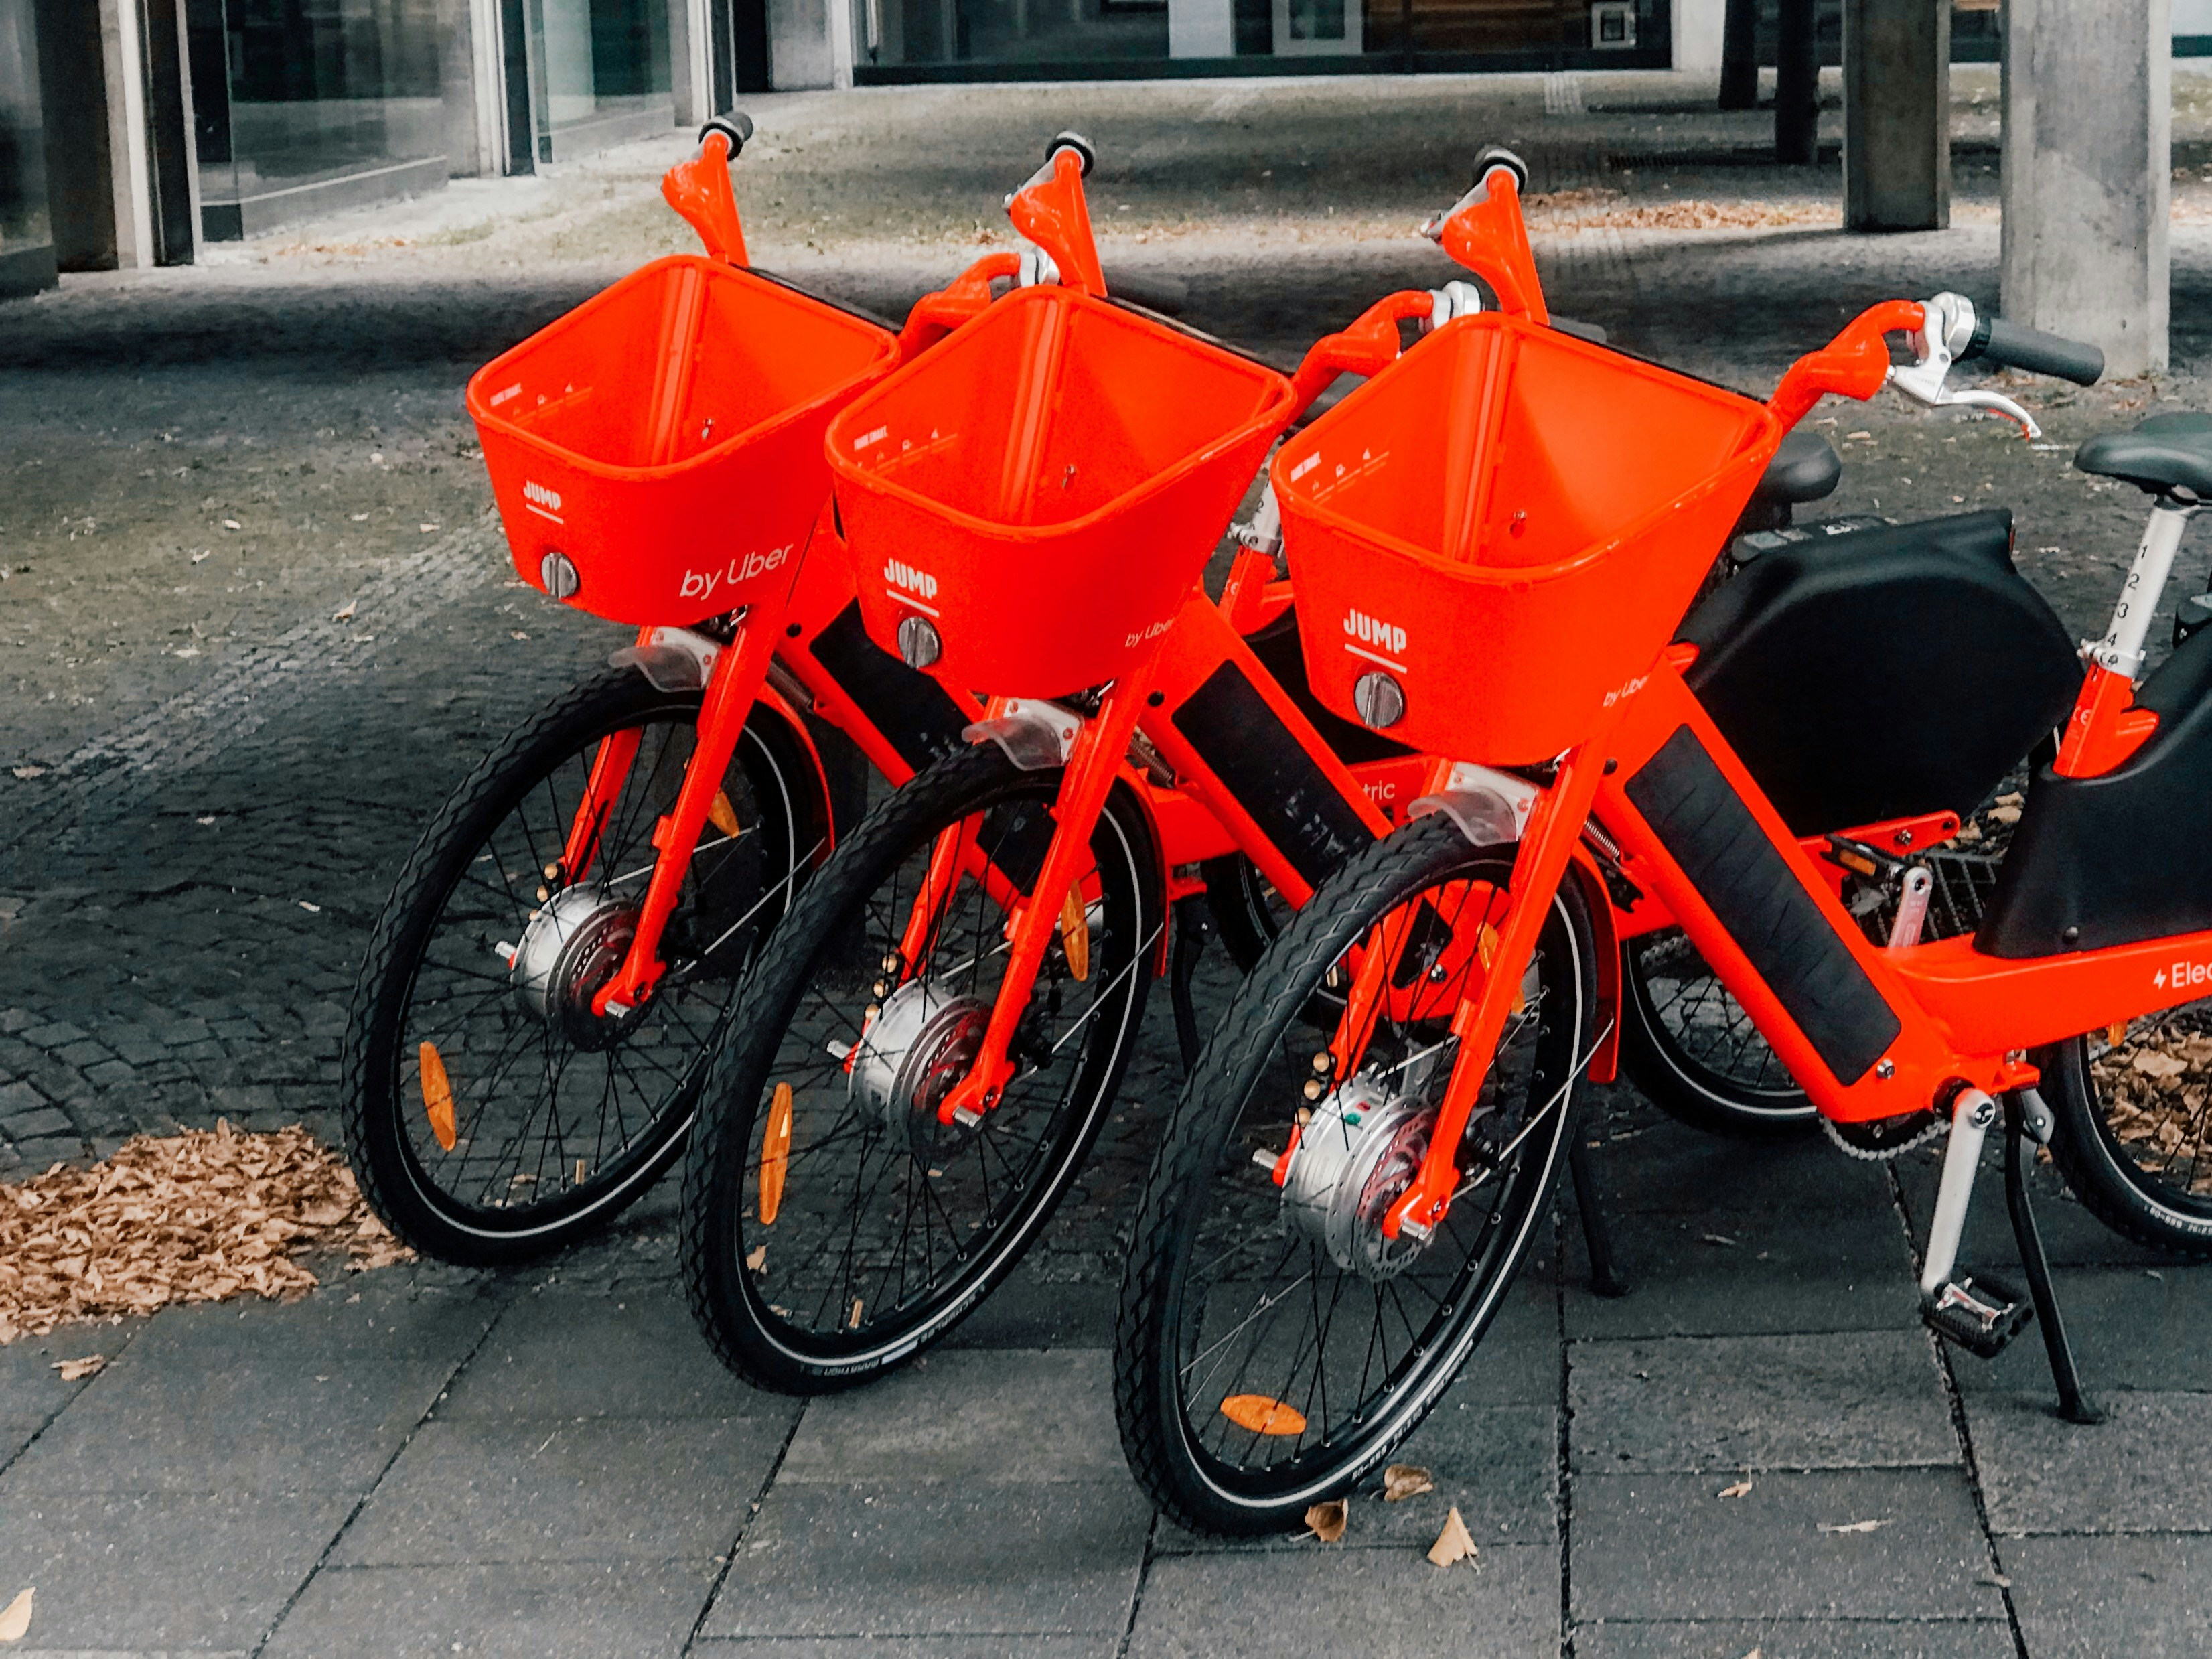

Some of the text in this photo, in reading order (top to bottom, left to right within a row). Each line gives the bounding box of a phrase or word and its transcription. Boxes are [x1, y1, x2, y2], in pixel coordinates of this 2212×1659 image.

[524, 480, 561, 511] JUMP
[2142, 545, 2148, 559] 1
[679, 543, 794, 601] by Uber
[884, 557, 937, 600] JUMP
[2128, 573, 2140, 590] 2
[2117, 603, 2128, 618] 3
[1343, 608, 1406, 654] JUMP
[2107, 632, 2117, 646] 4
[1125, 632, 1144, 648] by
[1603, 691, 1621, 707] by
